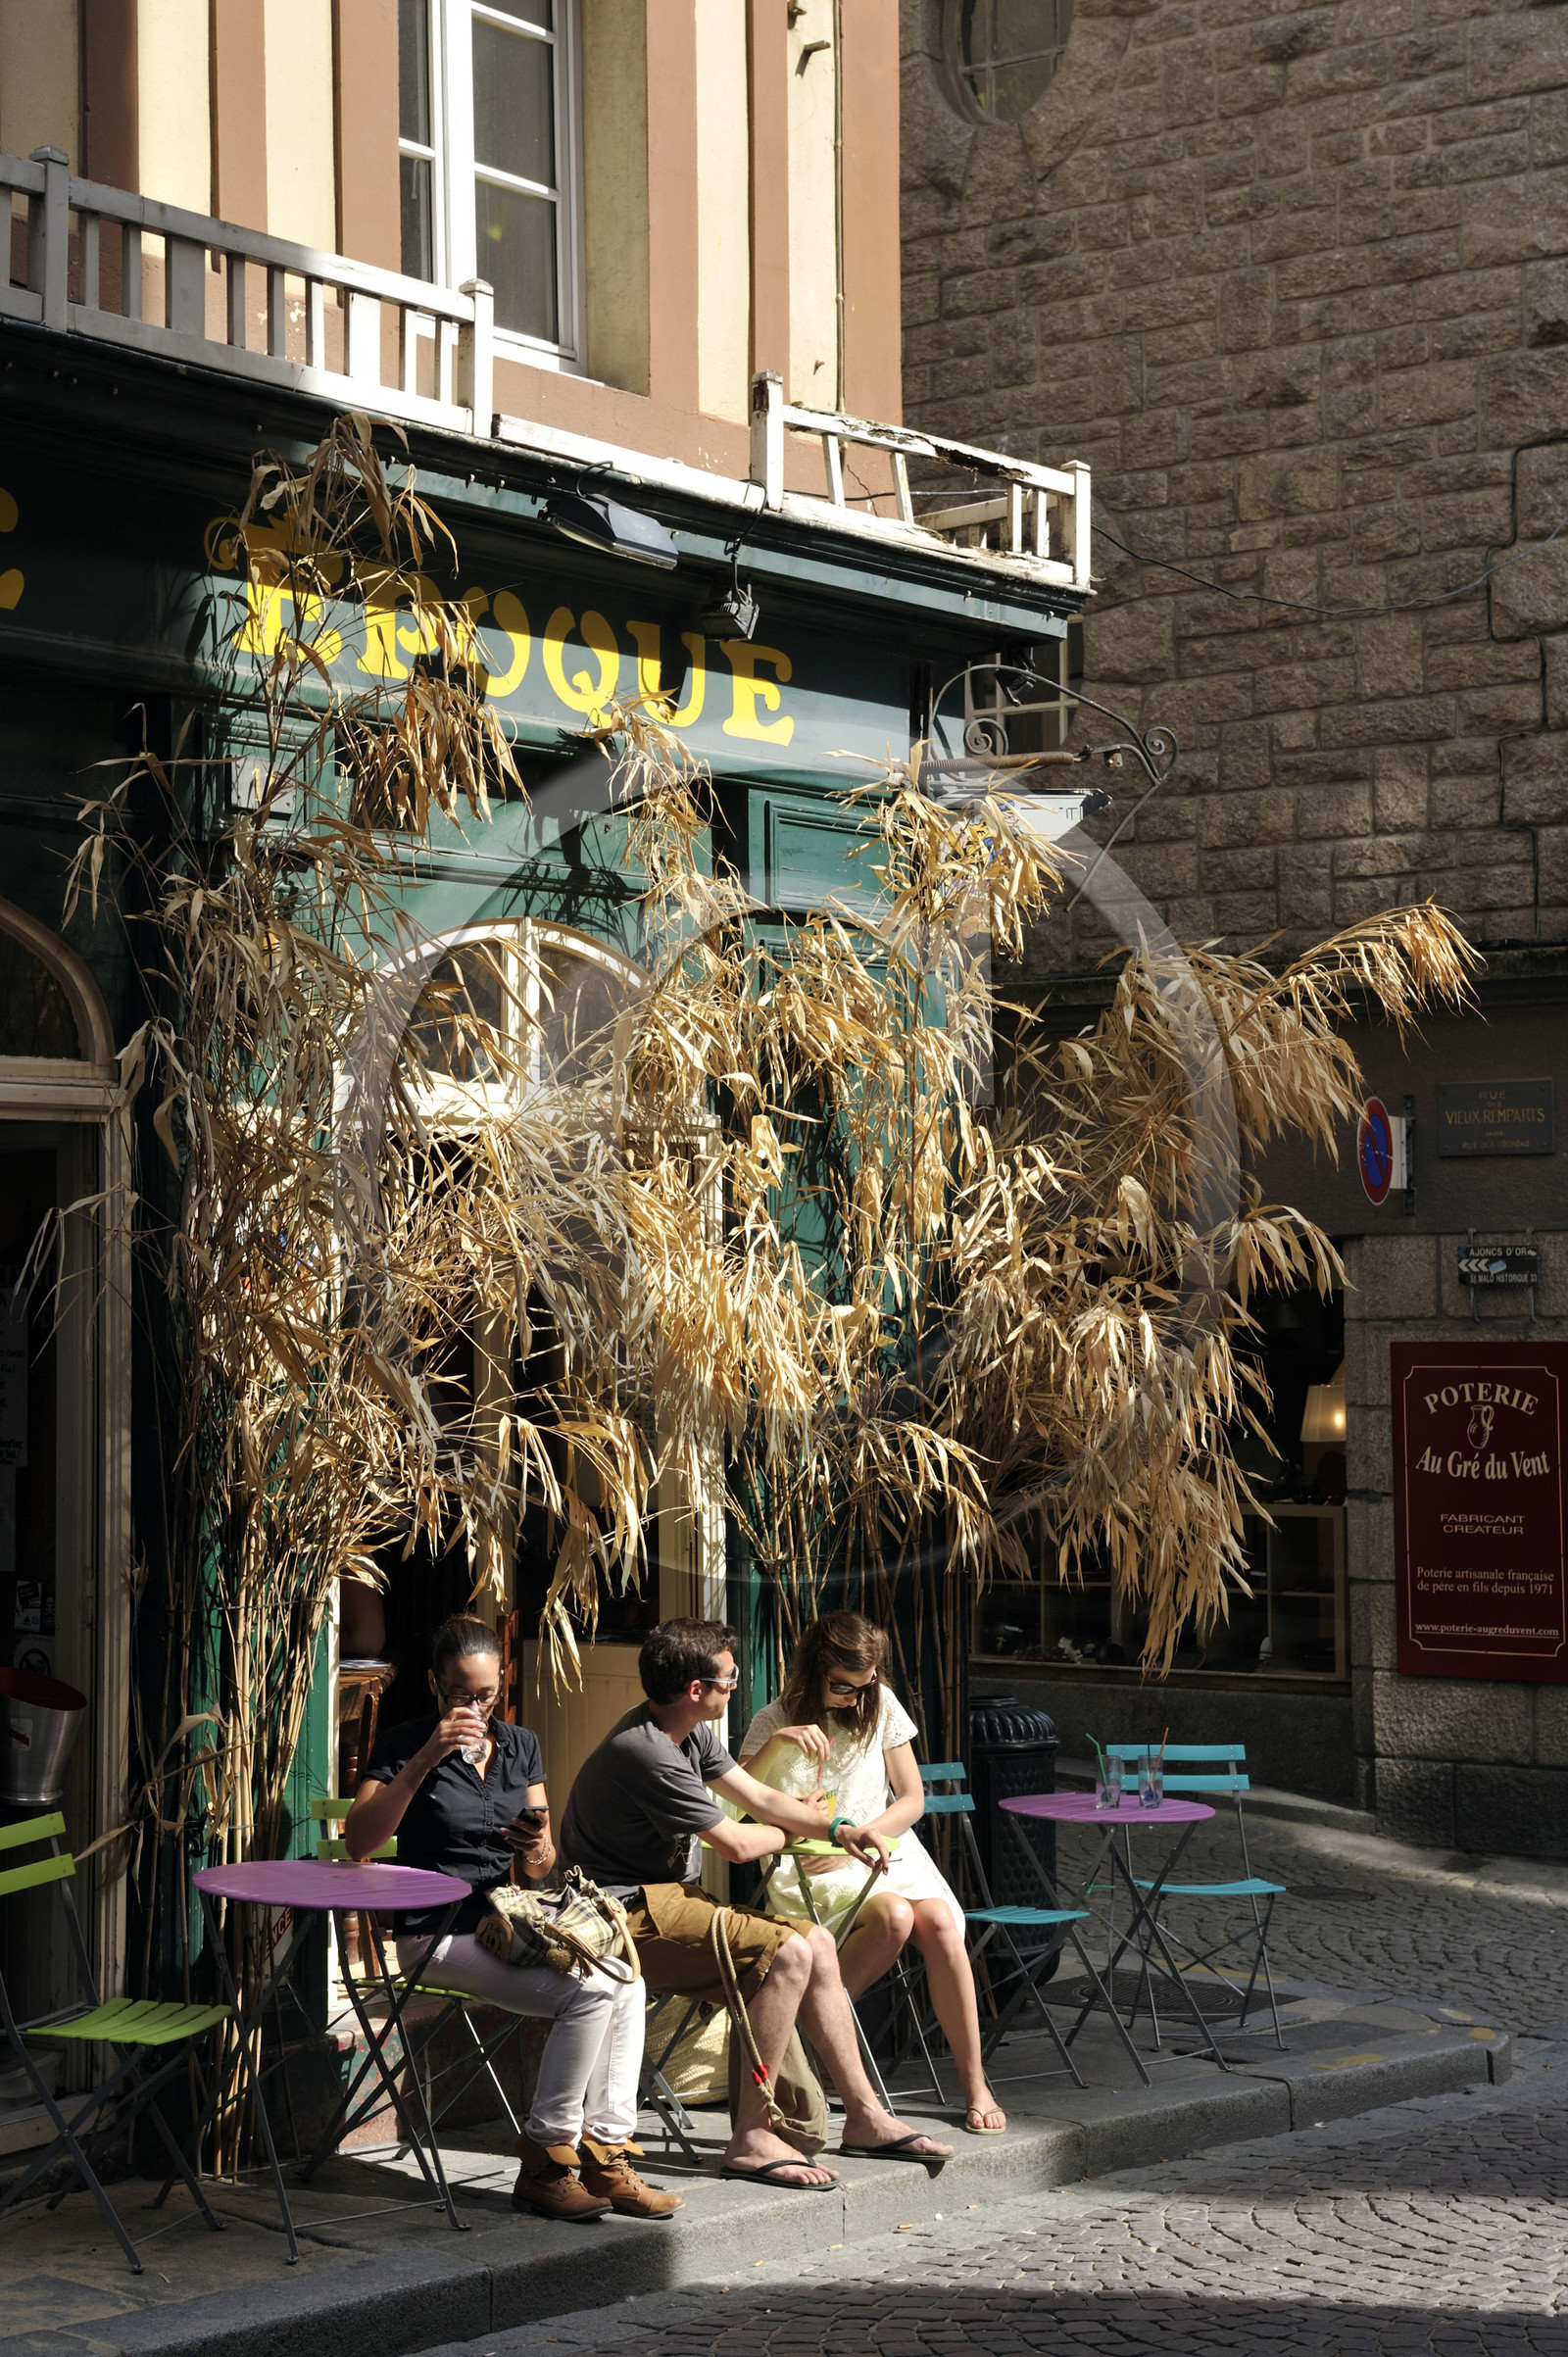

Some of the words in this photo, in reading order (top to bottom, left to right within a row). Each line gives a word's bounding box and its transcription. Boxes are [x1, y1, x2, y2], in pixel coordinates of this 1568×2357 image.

[1479, 1091, 1506, 1100] RUE
[1446, 1109, 1481, 1125] VIEUX
[1484, 1107, 1545, 1124] REMPARTS
[1469, 1247, 1503, 1256] AJONCS
[1478, 1273, 1494, 1283] MALO
[1495, 1273, 1529, 1283] HISTORIQUE
[1423, 1382, 1540, 1416] POTERIE
[1415, 1446, 1443, 1474] Au
[1446, 1450, 1480, 1479] Gré
[1485, 1452, 1508, 1480] du
[1509, 1450, 1550, 1479] Vent
[1440, 1513, 1526, 1524] FABRICANT
[1443, 1524, 1524, 1535] CREATEUR
[1416, 1566, 1452, 1578] Poterie
[1454, 1568, 1504, 1580] artisanale
[1507, 1569, 1554, 1582] française
[1417, 1580, 1430, 1591] de
[1456, 1583, 1470, 1592] en
[1472, 1581, 1489, 1593] fils
[1492, 1582, 1526, 1596] depuis
[1529, 1584, 1553, 1596] 1971
[1415, 1623, 1559, 1637] www.poterie-augreduvent.com
